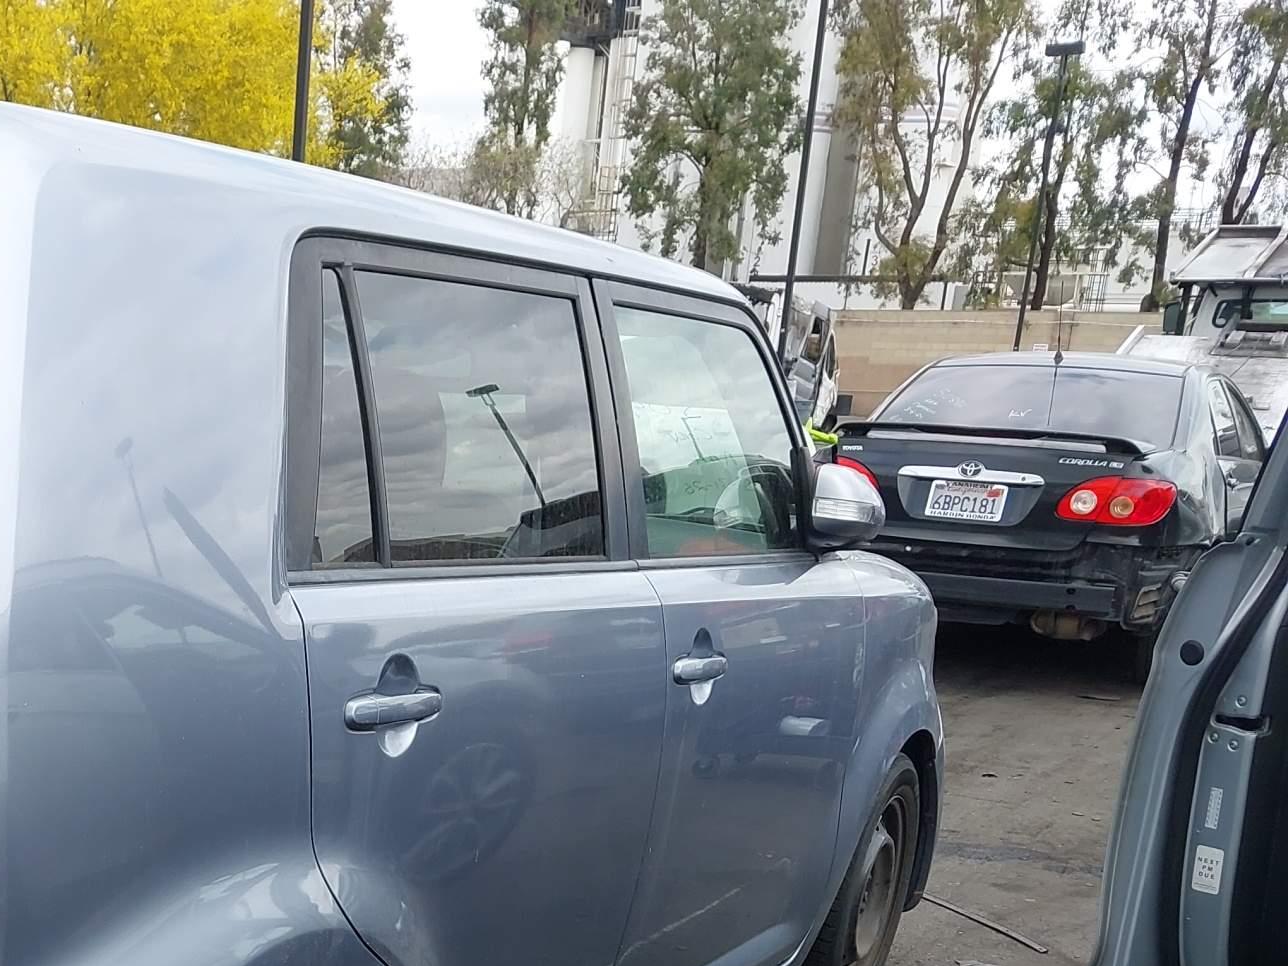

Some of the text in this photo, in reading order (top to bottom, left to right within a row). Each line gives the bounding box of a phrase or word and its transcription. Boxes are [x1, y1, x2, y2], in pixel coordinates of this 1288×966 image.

[871, 254, 879, 266] 3
[1058, 457, 1108, 467] COROLLA
[932, 494, 997, 514] 6BPC181
